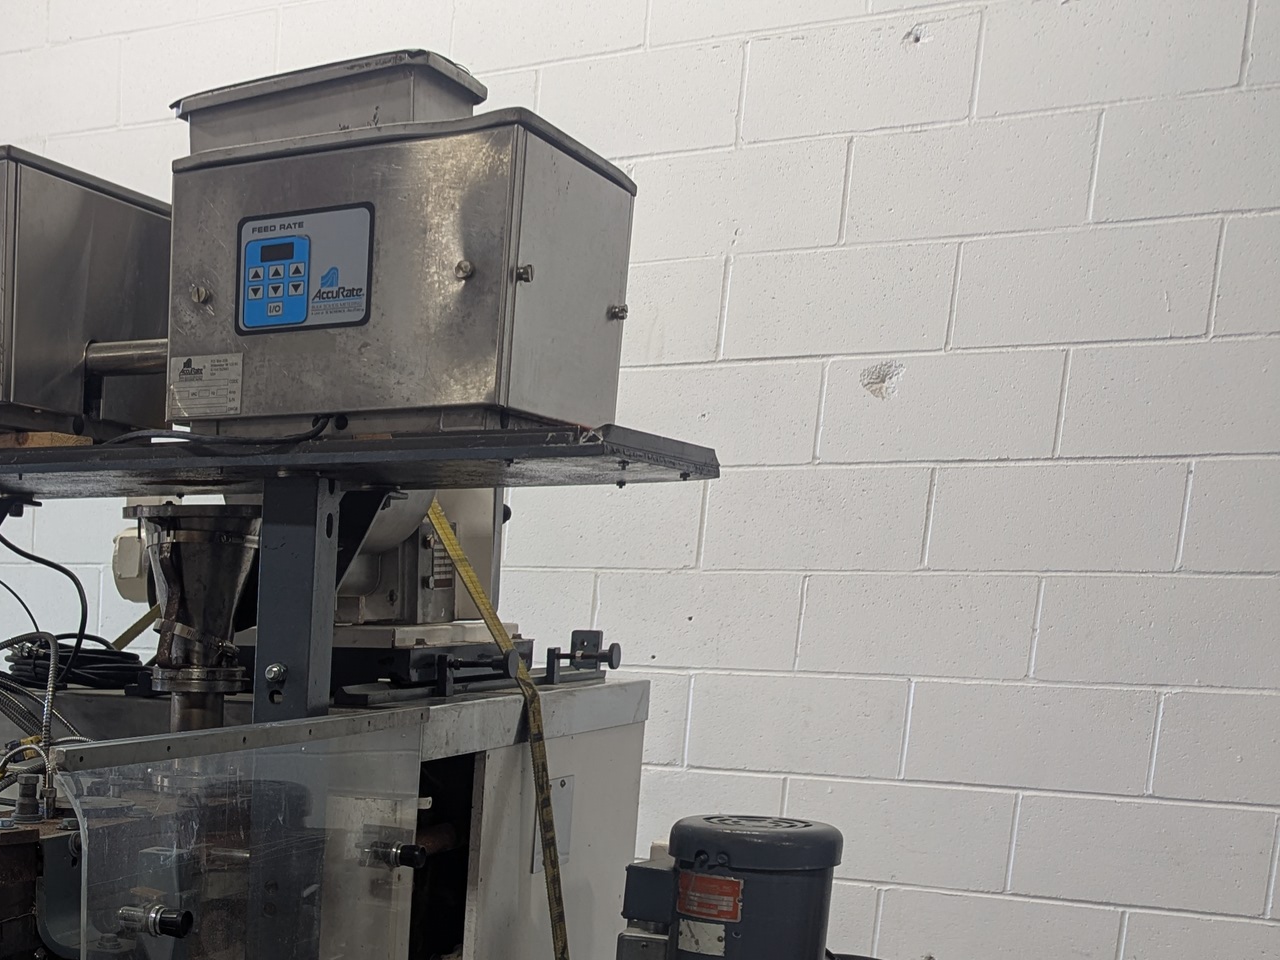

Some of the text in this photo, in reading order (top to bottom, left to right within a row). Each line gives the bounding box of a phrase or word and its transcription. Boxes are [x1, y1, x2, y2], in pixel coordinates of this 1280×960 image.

[251, 221, 305, 234] FEED RATE
[312, 286, 363, 301] AccuRate
